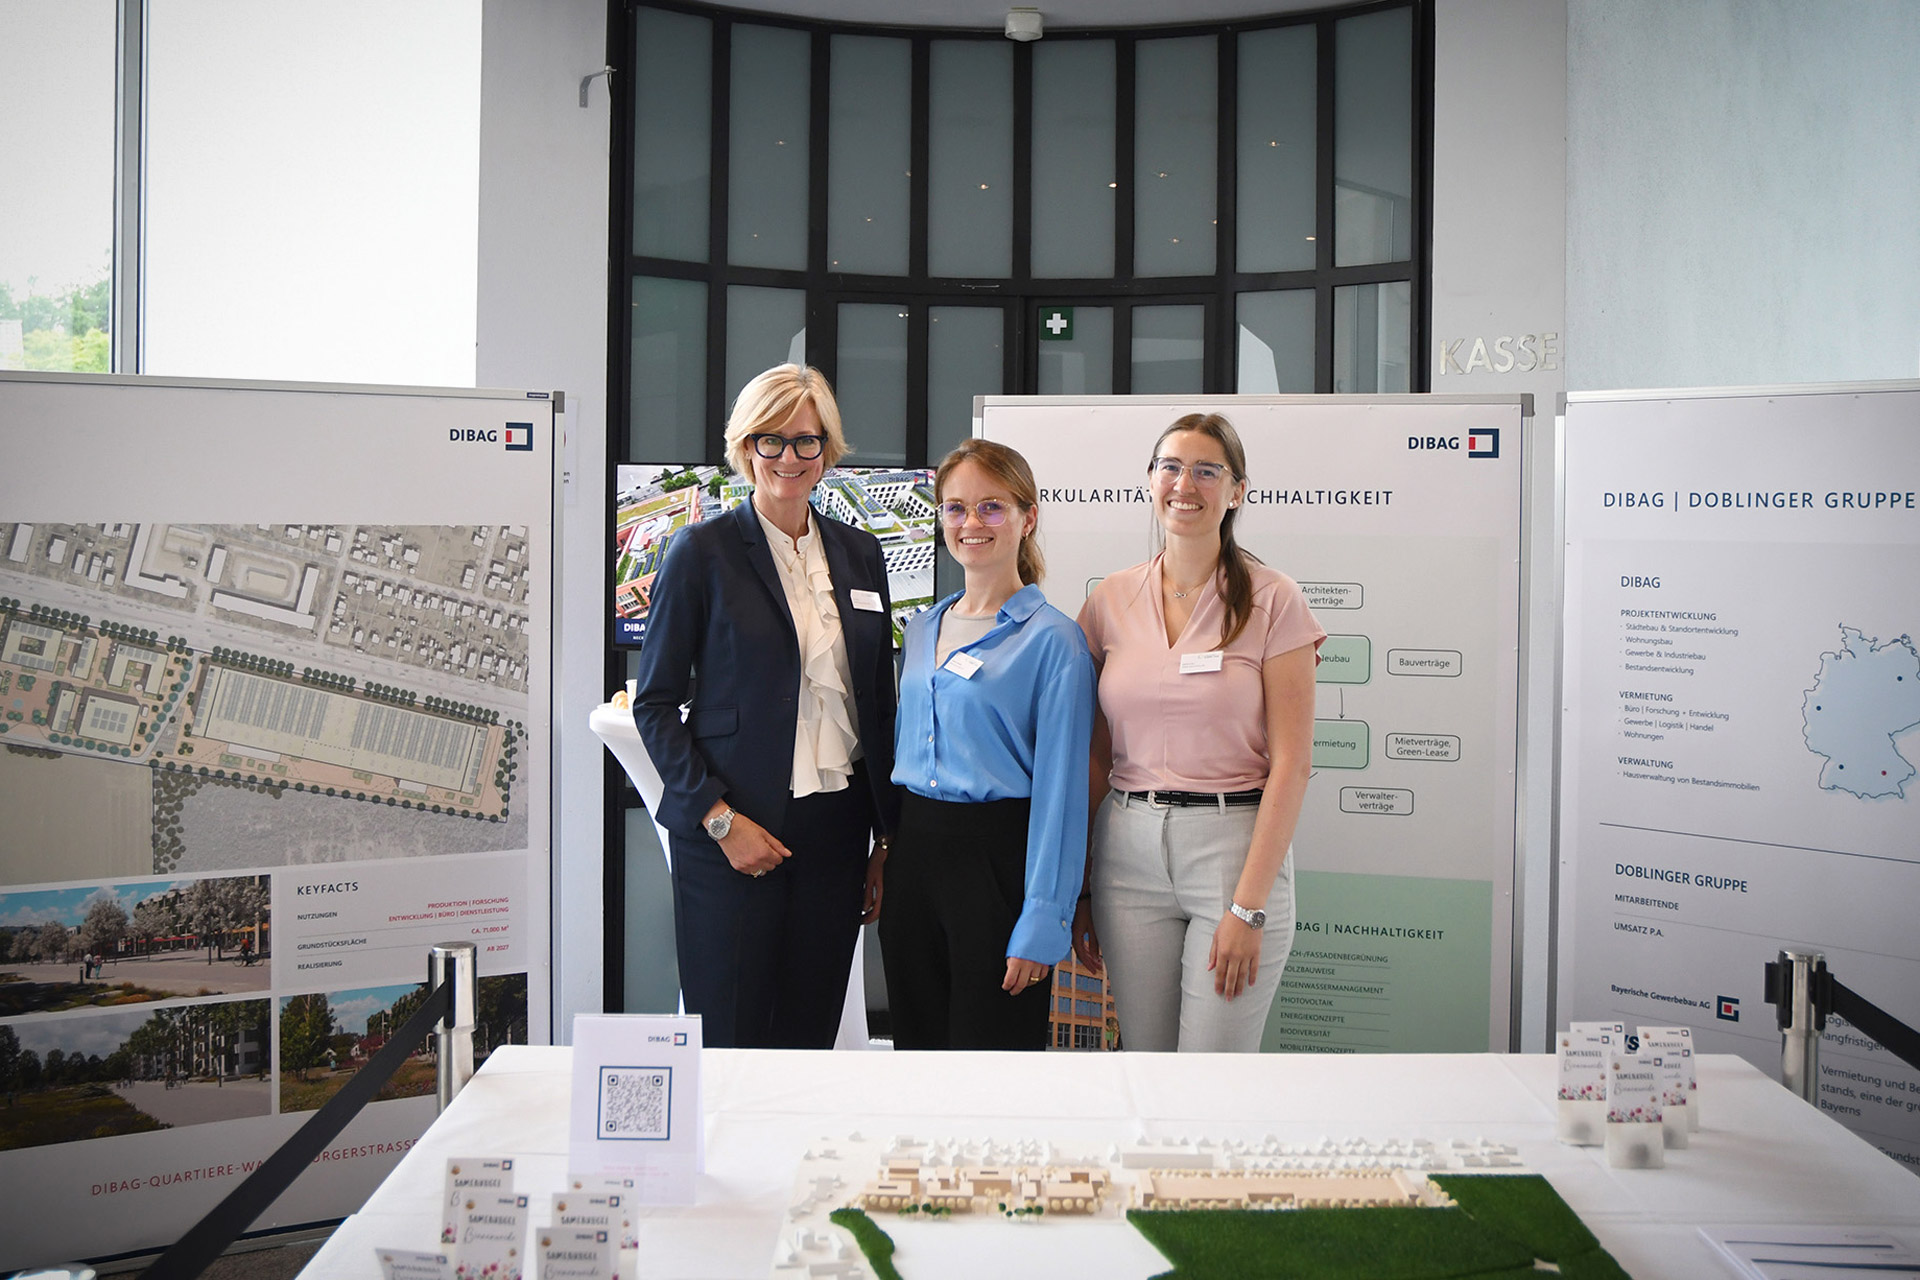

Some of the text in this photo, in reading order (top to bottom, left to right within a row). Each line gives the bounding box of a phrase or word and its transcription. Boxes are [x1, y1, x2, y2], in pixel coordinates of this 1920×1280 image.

[1439, 332, 1558, 376] KASSE
[448, 428, 497, 442] DIBAG
[1407, 436, 1459, 450] DIBAG
[1246, 489, 1393, 505] CHHALTIGKEIT
[1603, 492, 1665, 508] DIBAG
[1689, 492, 1814, 508] DOBLINGER
[1824, 491, 1915, 509] GRUPPE
[1620, 575, 1661, 589] DIBAG
[1302, 586, 1352, 595] Architekten-
[1309, 596, 1344, 606] verträge
[1620, 609, 1717, 621] PROJEKTENTWICKLUNG
[623, 623, 646, 632] DIBA
[1626, 623, 1739, 637] Städtebau & Standortentwicklung
[1625, 636, 1673, 646] Wohnungsbau
[1625, 649, 1706, 660] Gewerbe & Industriebau
[1399, 658, 1450, 669] Bauverträge
[1625, 663, 1694, 676] Bestandsentwicklung
[1619, 691, 1673, 702] VERMIETUNG
[1624, 704, 1640, 713] Büro
[1645, 706, 1680, 717] Forschung
[1689, 710, 1730, 721] Entwicklung
[1624, 718, 1653, 727] Gewerbe
[1659, 721, 1684, 731] Logistik
[1690, 723, 1714, 731] Handel
[1395, 737, 1451, 748] Mietverträge,
[1624, 731, 1664, 741] Wohnungen
[1312, 739, 1356, 750] ermietung
[1396, 747, 1449, 757] Green-Lease
[1617, 756, 1674, 769] VERWALTUNG
[1622, 771, 1675, 784] Hausverwaltung
[1692, 777, 1760, 791] Bestandsimmobilien
[1355, 791, 1398, 800] Verwalter-
[1359, 801, 1394, 811] verträge
[1615, 863, 1748, 893] DOBLINGER GRUPPE
[297, 881, 359, 896] KEYFACTS
[427, 901, 468, 909] PRODUKTION
[472, 897, 509, 905] FORSCHUNG
[1614, 894, 1679, 911] MITARBEITENDE
[297, 911, 338, 921] NUTZUNGEN
[388, 913, 434, 922] ENTWICKLUNG
[460, 907, 509, 916] DIENSTLEISTUNG
[1296, 922, 1320, 932] BAG
[1334, 924, 1445, 940] NACHHALTIGKEIT
[1614, 922, 1664, 937] UMSATZ P.A.
[297, 938, 367, 950] GRUNDSTÜCKSFLÄCHE
[1289, 950, 1389, 963] CH-/FASSADENBEGRÜNUNG
[297, 960, 343, 970] REALISIERUNG
[1280, 981, 1384, 994] REGENWASSERMANAGEMENT
[1280, 996, 1334, 1006] PHOTOVOLTAIK
[1611, 984, 1710, 1009] Bayerische Gewerbebau AG
[1280, 1012, 1345, 1023] ENERGIEKONZEPTE
[1280, 1027, 1330, 1037] BIODIVERSITÄT
[1821, 1064, 1882, 1087] Vermietung
[1885, 1080, 1906, 1091] und
[1820, 1083, 1857, 1098] stands,
[1860, 1092, 1883, 1104] eine
[1885, 1095, 1903, 1107] der
[1820, 1099, 1861, 1116] Bayerns
